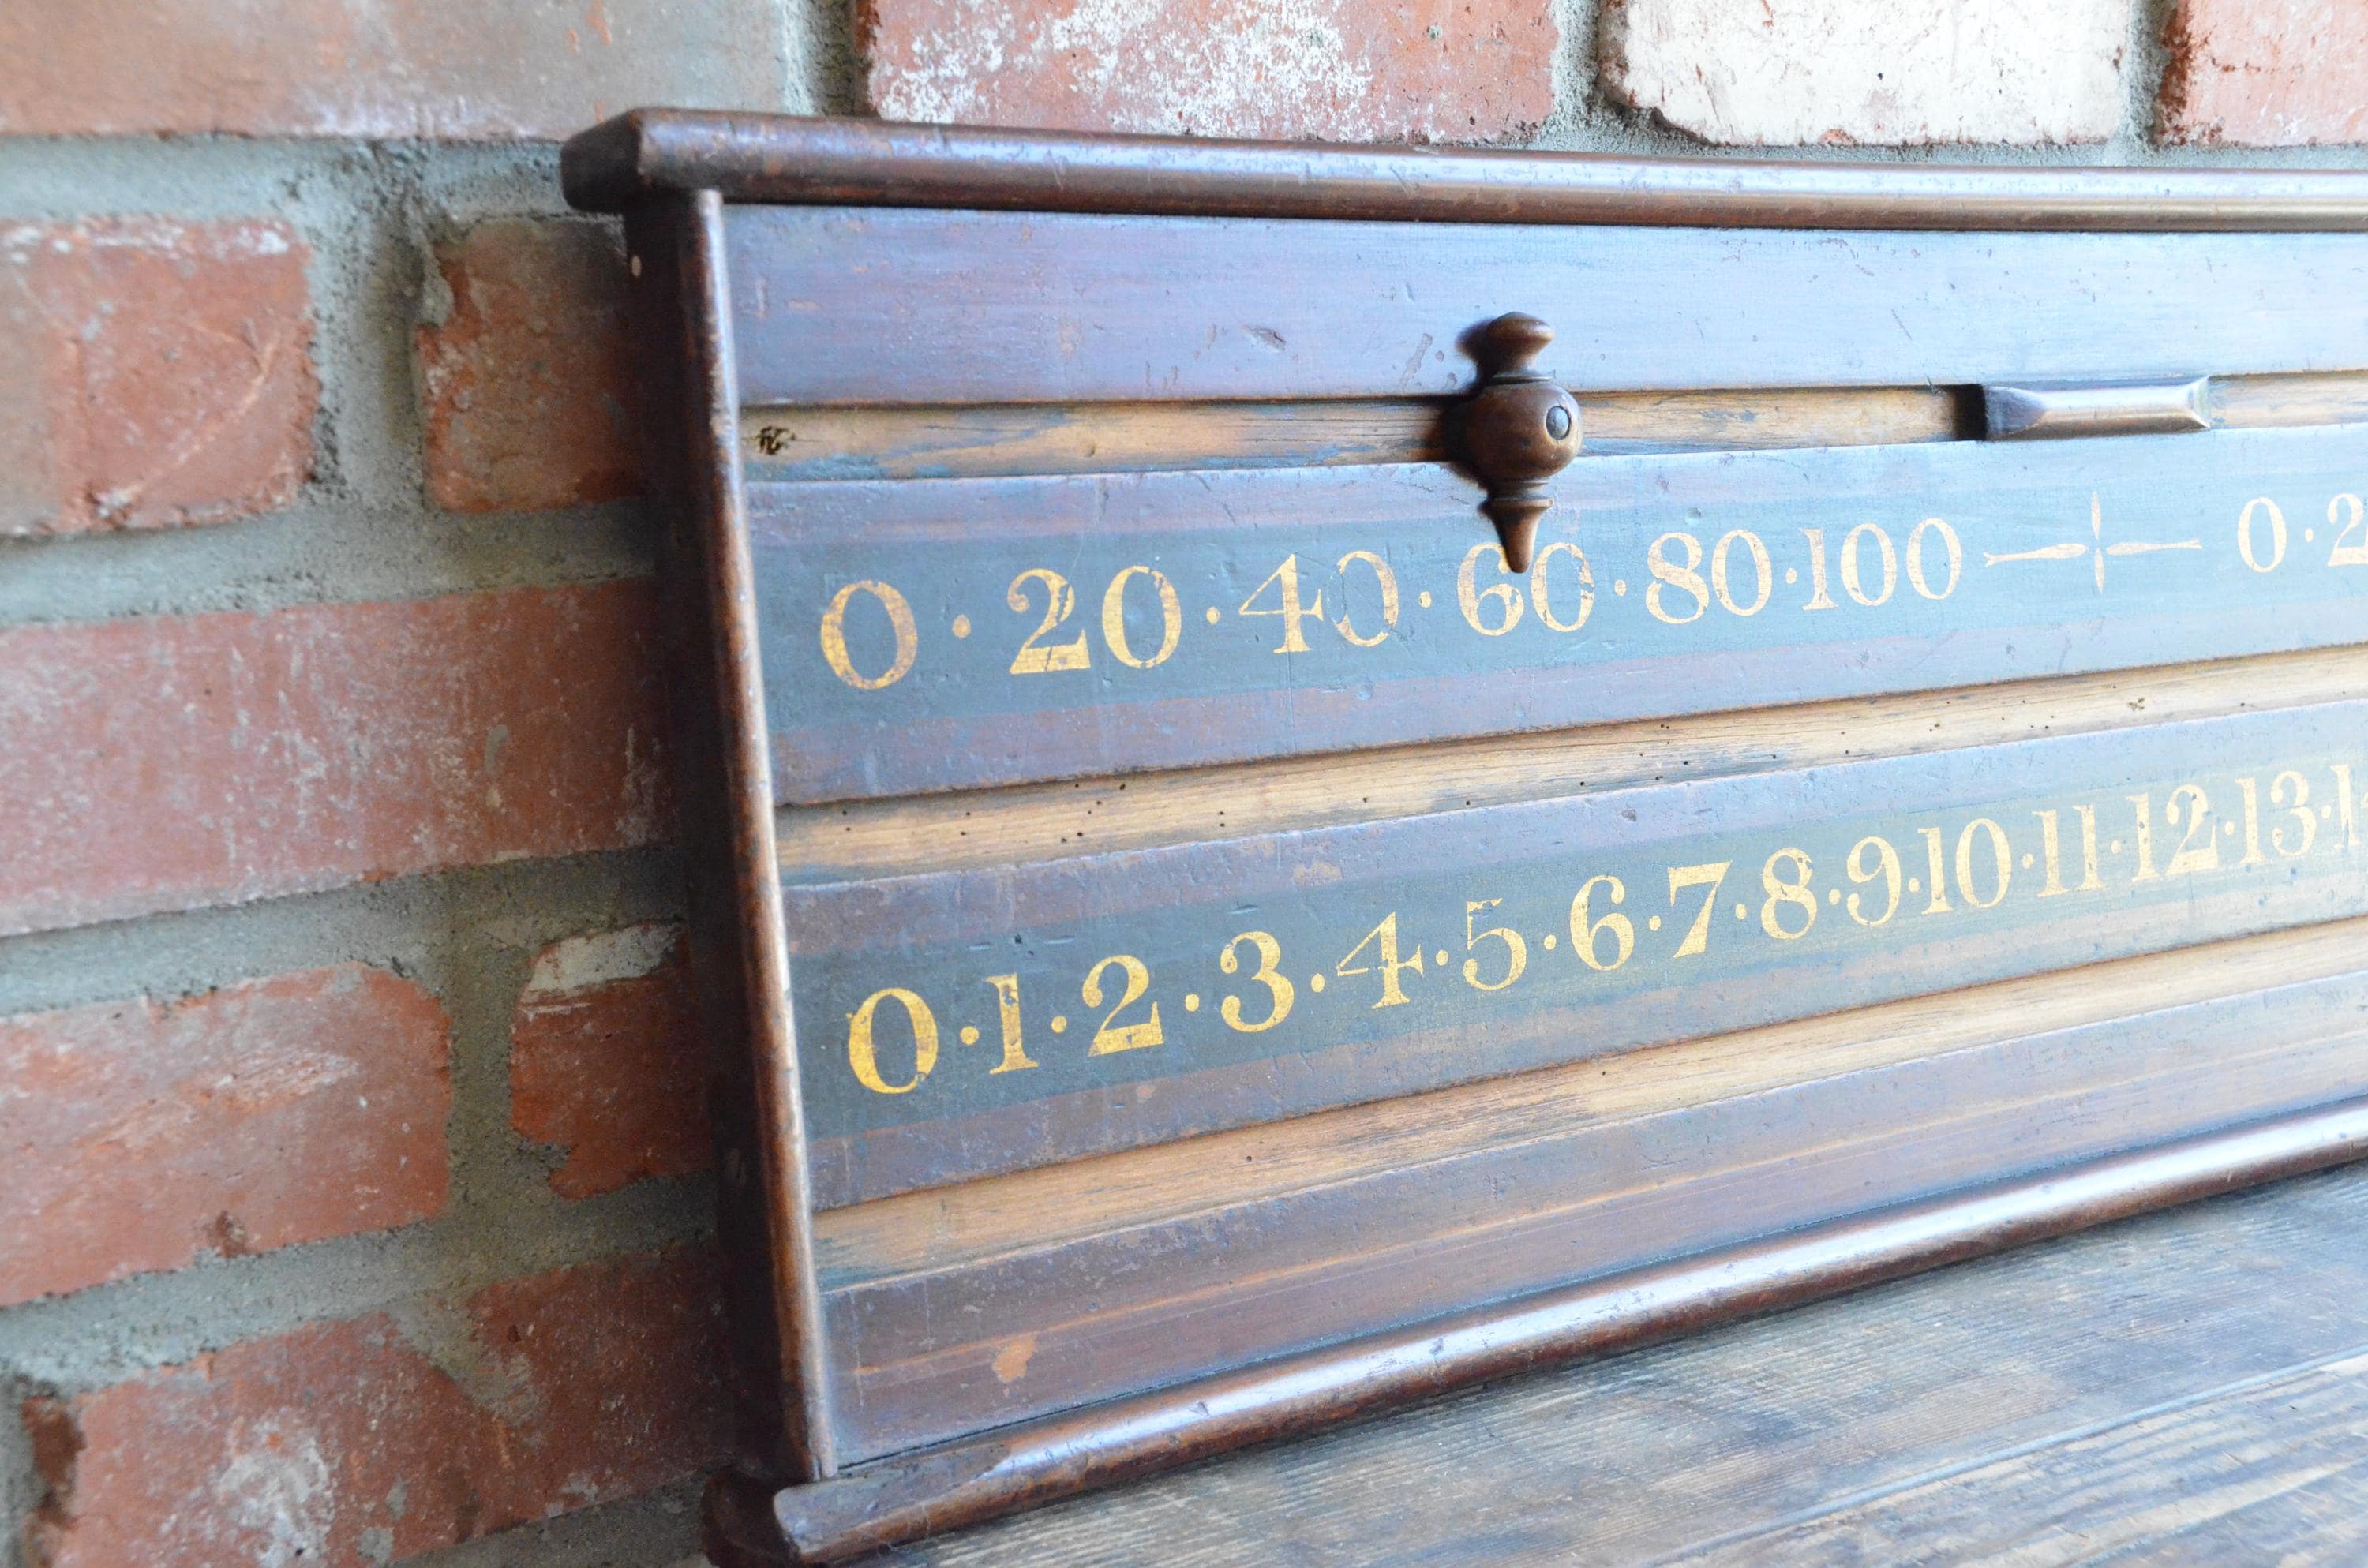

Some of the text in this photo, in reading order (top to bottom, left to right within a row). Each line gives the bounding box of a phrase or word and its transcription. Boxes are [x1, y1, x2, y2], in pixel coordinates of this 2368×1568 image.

[820, 518, 1962, 690] 0 20 40 60 80 100
[2238, 497, 2287, 573] 0
[848, 764, 2368, 1094] 0 1 2 3 4 5 6 7 8 9 10 11 12 13 1
